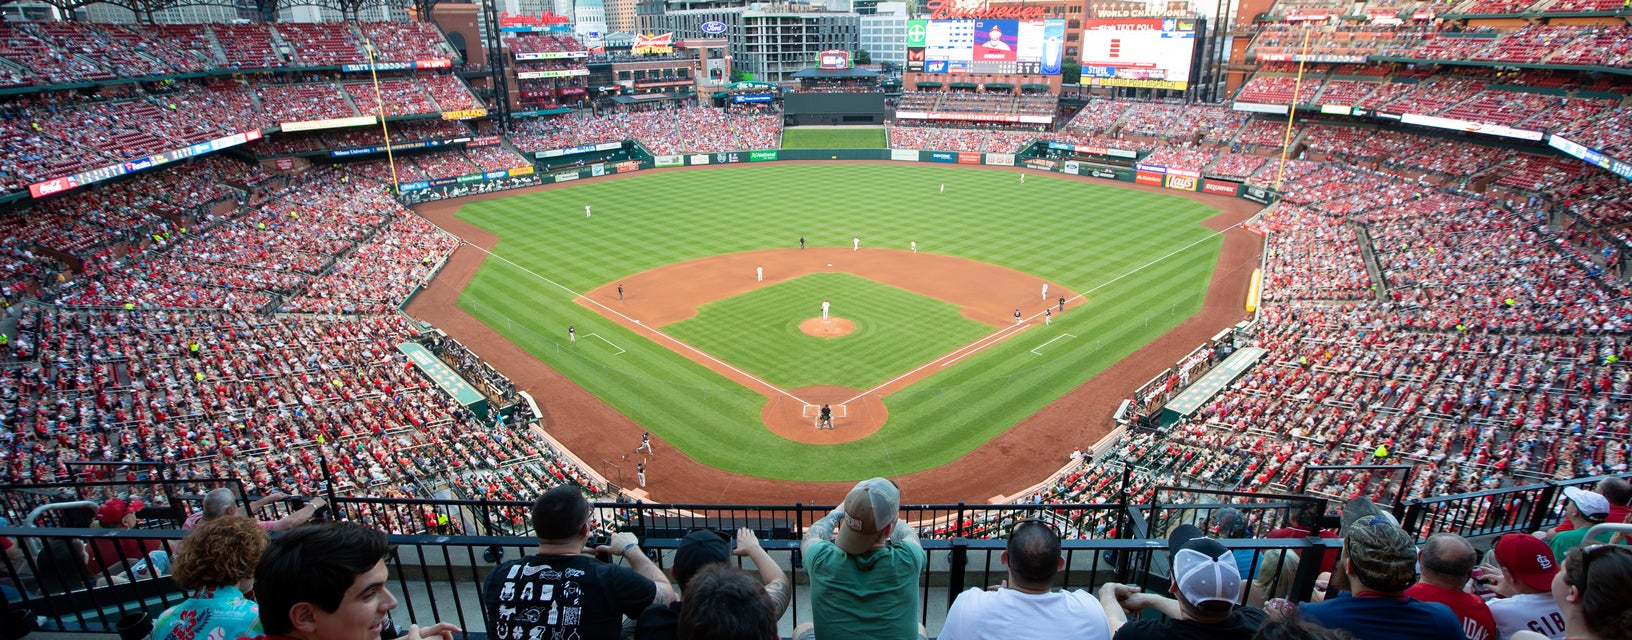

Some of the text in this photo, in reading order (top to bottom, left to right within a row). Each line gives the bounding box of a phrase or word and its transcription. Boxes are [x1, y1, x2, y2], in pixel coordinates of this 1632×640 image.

[926, 0, 1047, 20] Budweiser
[1098, 9, 1187, 17] WORLD CHAMPIONS
[706, 21, 722, 31] Ford
[653, 45, 673, 54] HOUSE
